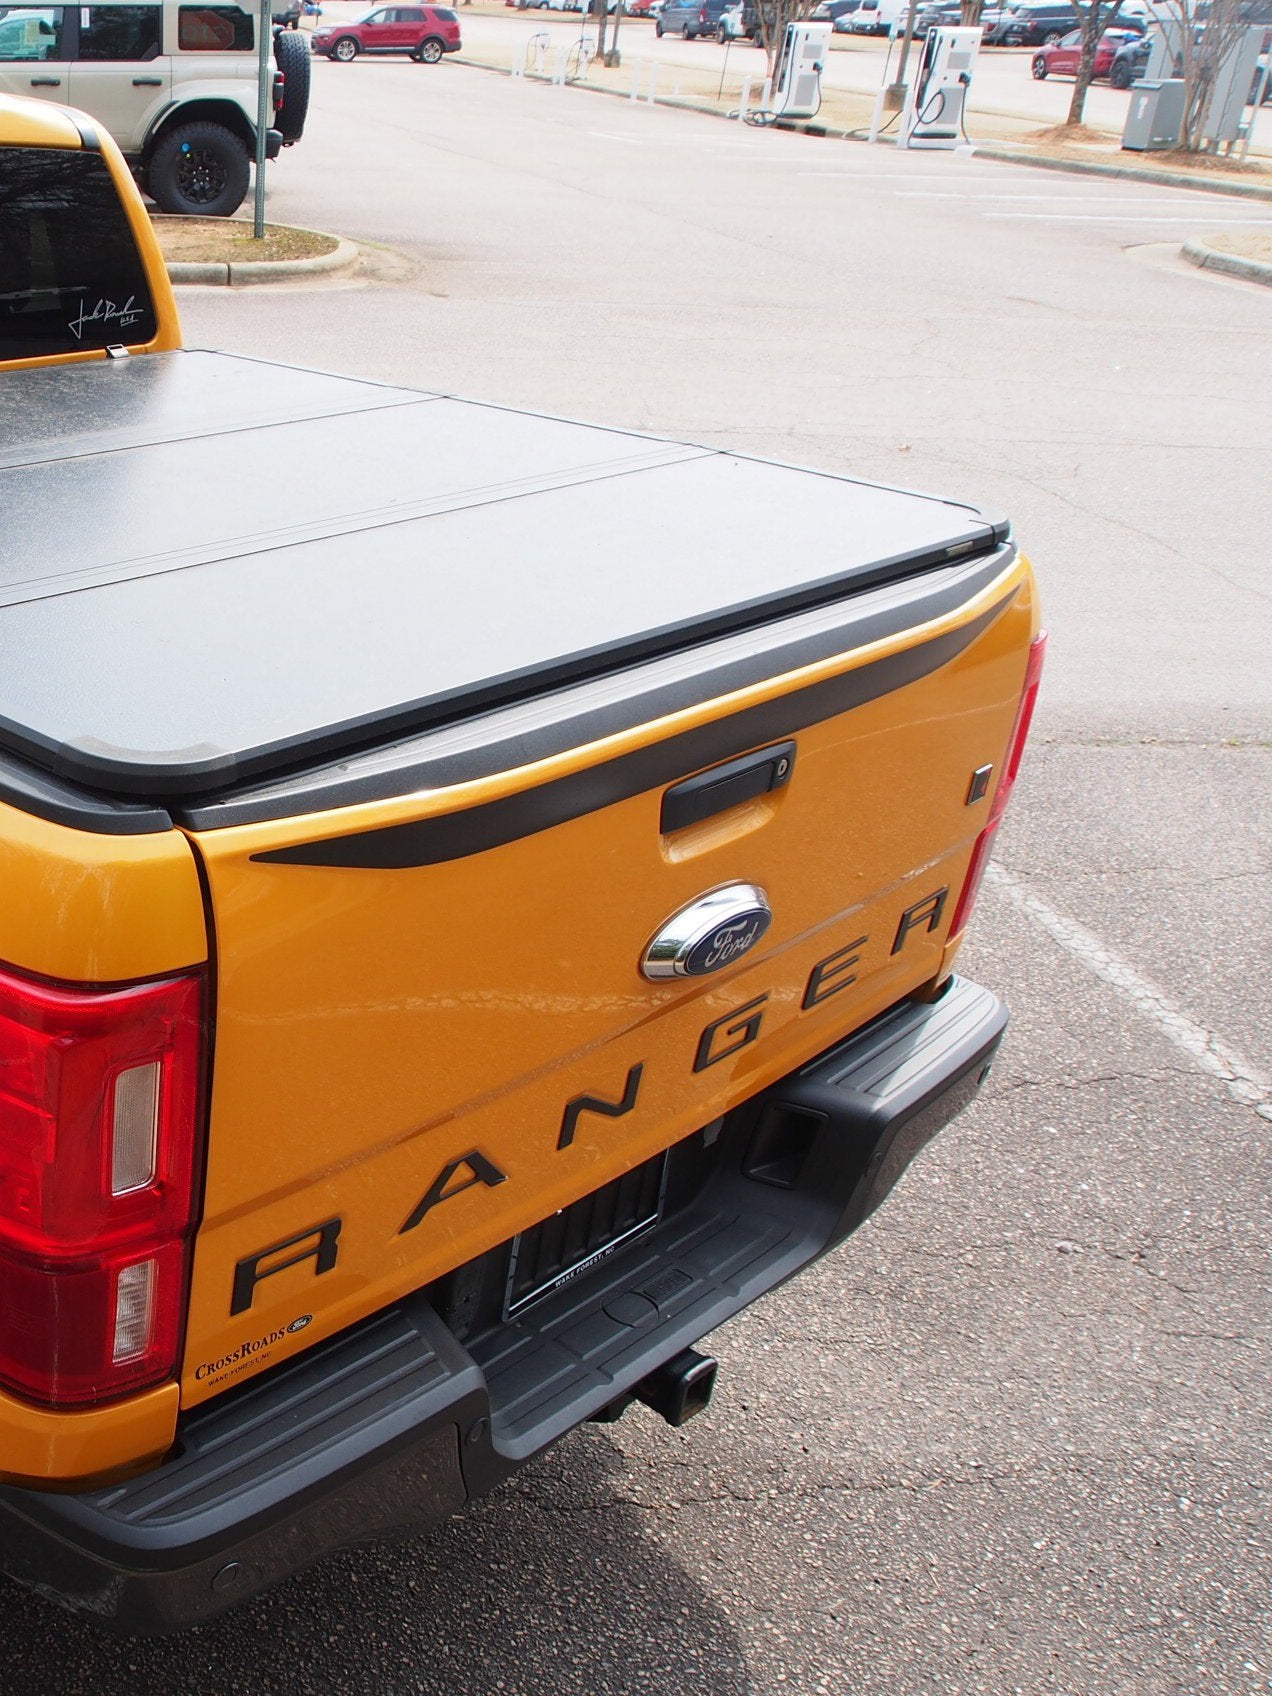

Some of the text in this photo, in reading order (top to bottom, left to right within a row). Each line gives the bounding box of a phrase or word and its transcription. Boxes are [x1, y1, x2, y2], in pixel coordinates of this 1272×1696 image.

[705, 920, 759, 968] Ford
[230, 887, 948, 1318] RANGER
[555, 1271, 575, 1287] WAKE
[605, 1246, 615, 1256] NC
[208, 1372, 228, 1386] WAKE
[261, 1351, 272, 1360] NC
